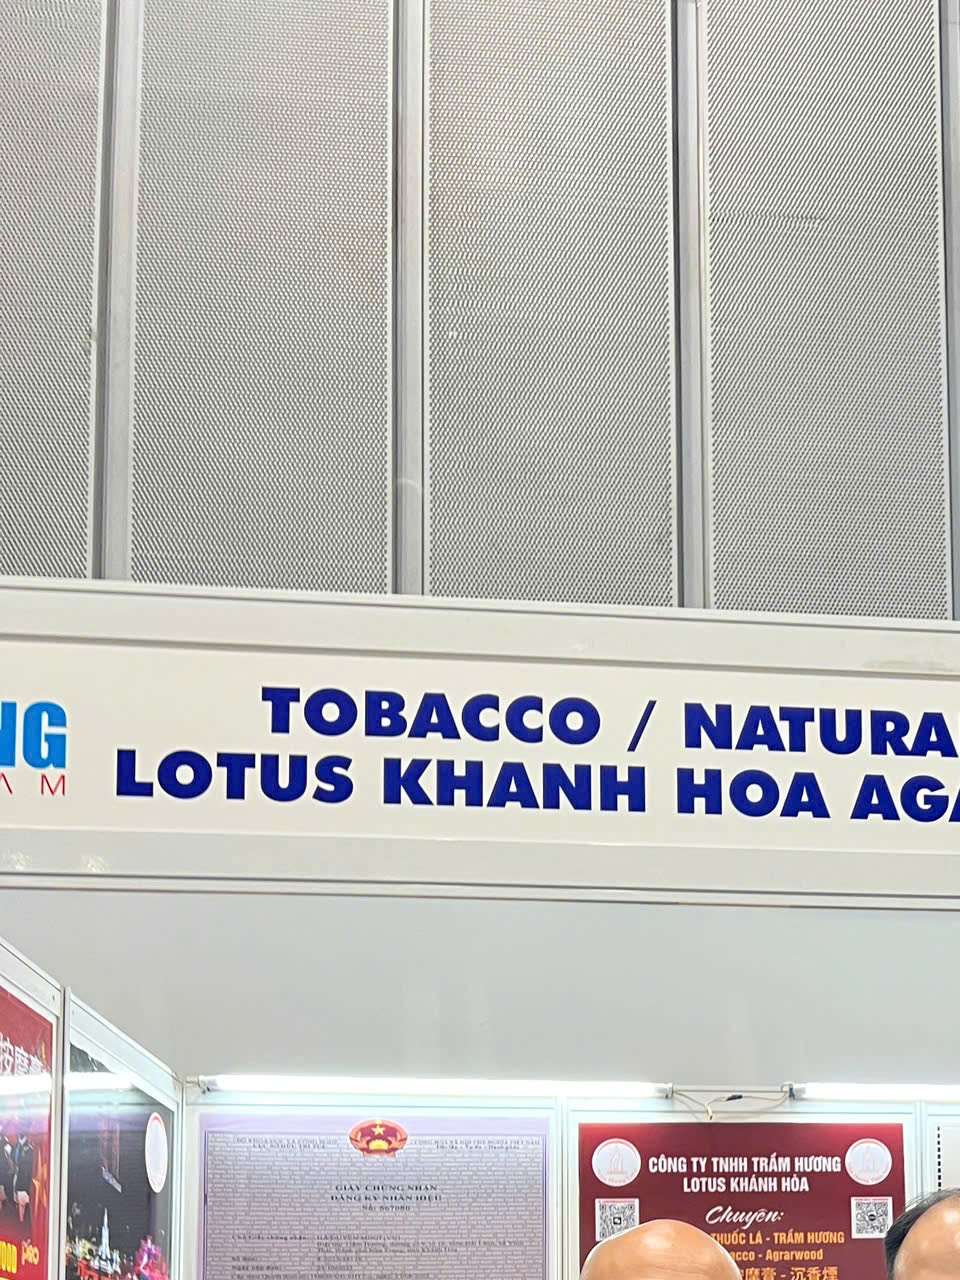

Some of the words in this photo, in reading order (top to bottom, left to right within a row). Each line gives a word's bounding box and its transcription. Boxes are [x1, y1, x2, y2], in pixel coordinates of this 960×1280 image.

[261, 686, 601, 746] TOBACCO
[627, 700, 657, 752] /
[115, 748, 354, 806] LOTUS
[383, 758, 648, 814] KHANH
[676, 767, 832, 820] HOA
[648, 1154, 688, 1174] CÔNG
[691, 1157, 709, 1174] TY
[711, 1157, 748, 1174] TNHH
[794, 1155, 842, 1173] HƯƠNG
[683, 1177, 726, 1193] LOTUS
[730, 1173, 778, 1193] KHÁNH
[705, 1204, 785, 1230] Chuyên:
[749, 1230, 763, 1245] LÁ
[807, 1230, 845, 1244] HƯƠNG
[765, 1248, 824, 1262] Agrarwood
